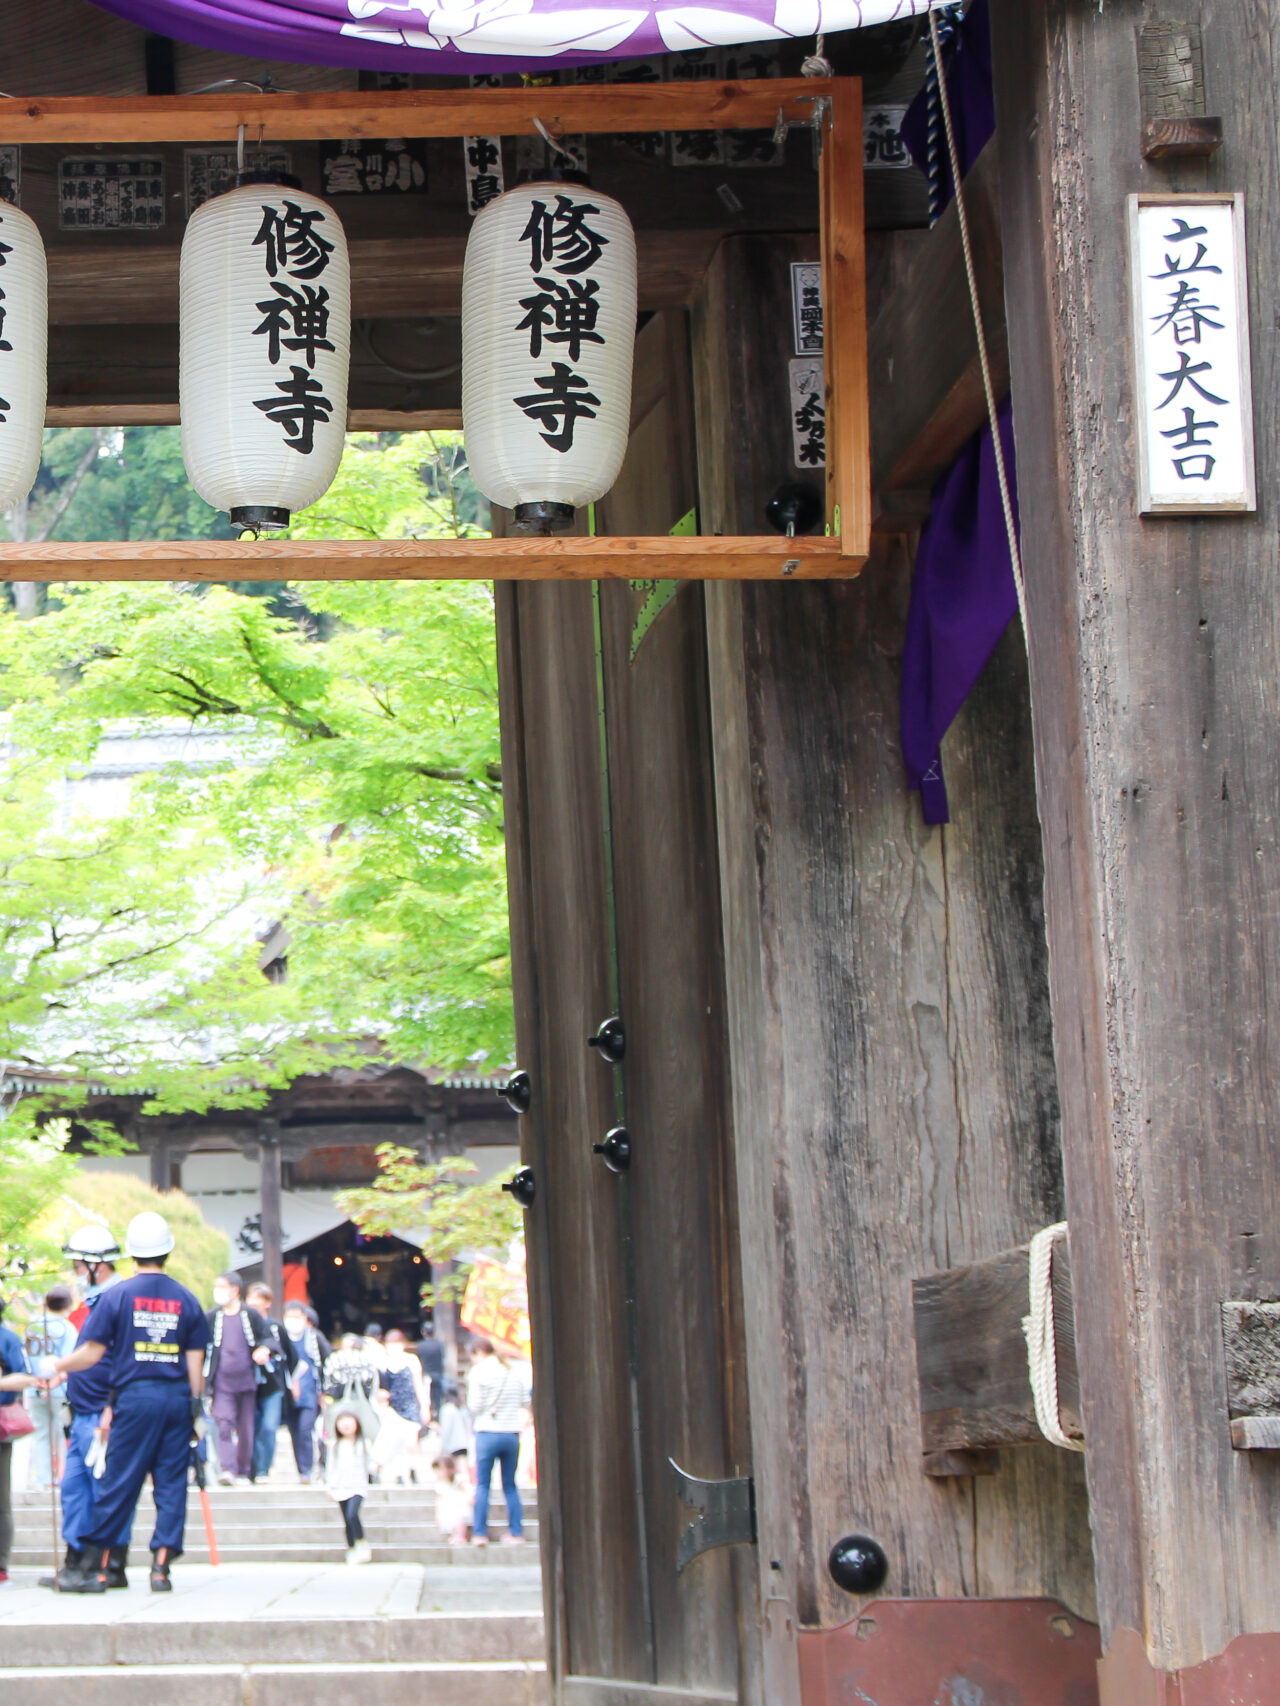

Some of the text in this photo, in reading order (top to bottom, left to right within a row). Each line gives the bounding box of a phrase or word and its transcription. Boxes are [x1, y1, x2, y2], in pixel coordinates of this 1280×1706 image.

[251, 201, 336, 455] 修禅寺
[513, 195, 610, 453] 修禅寺
[1147, 218, 1230, 481] 立春大吉
[133, 1296, 182, 1315] FIRE
